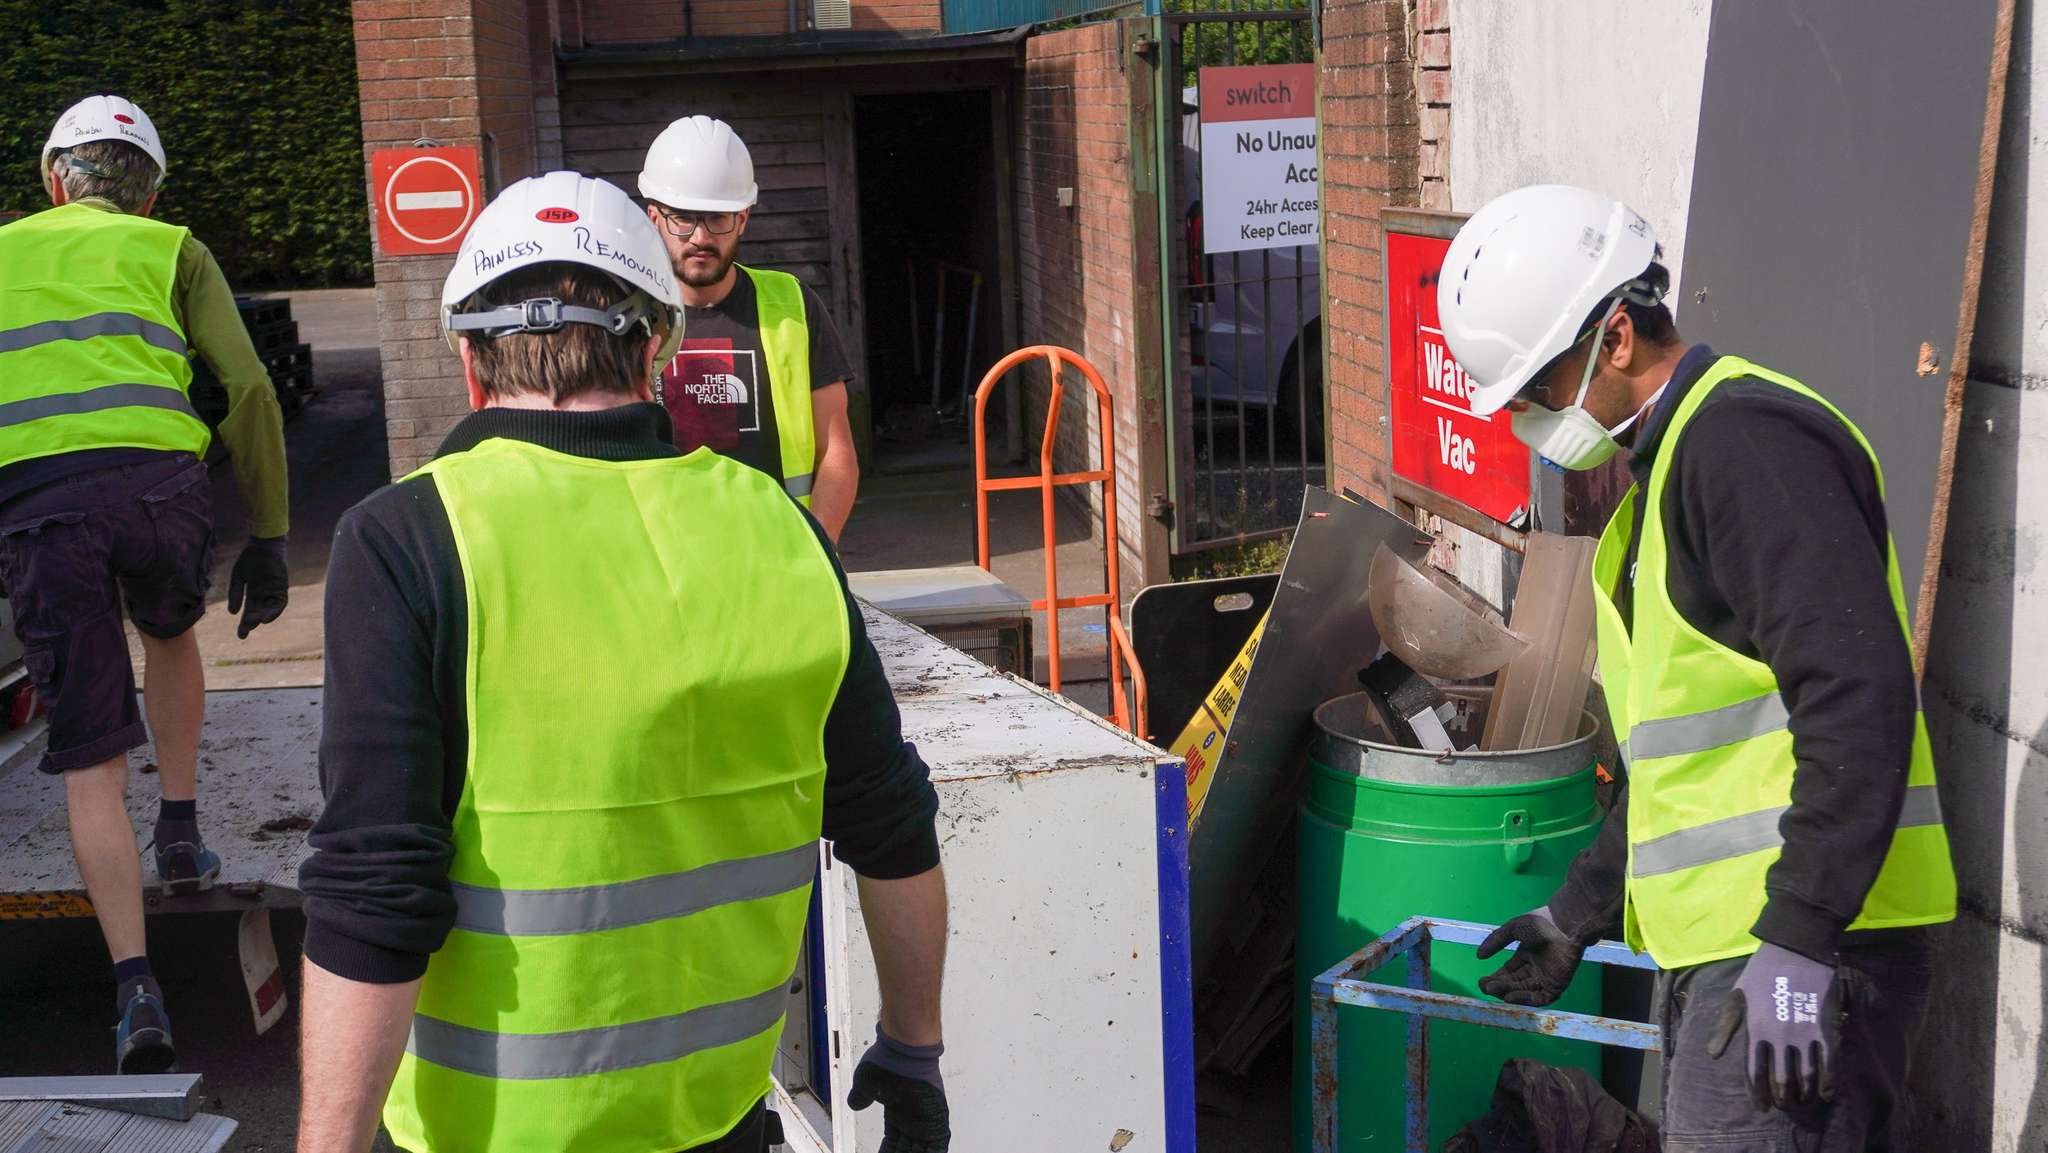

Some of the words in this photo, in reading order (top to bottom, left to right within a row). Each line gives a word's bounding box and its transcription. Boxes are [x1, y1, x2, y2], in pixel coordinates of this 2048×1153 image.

[1226, 81, 1291, 106] switch
[1236, 132, 1263, 153] No
[1268, 131, 1316, 151] Unau
[1285, 163, 1318, 183] Acc
[542, 211, 573, 220] JSP
[1246, 201, 1278, 216] 24hr
[1280, 198, 1318, 213] Acces
[1241, 225, 1275, 241] Keep
[1278, 222, 1313, 237] Clear
[474, 239, 543, 276] PAINLESS
[573, 226, 669, 295] REMOVALS
[702, 374, 725, 384] THE
[685, 384, 726, 394] NORTH
[697, 394, 726, 403] FACE
[1437, 416, 1476, 475] Vac
[1213, 685, 1235, 717] LARGE
